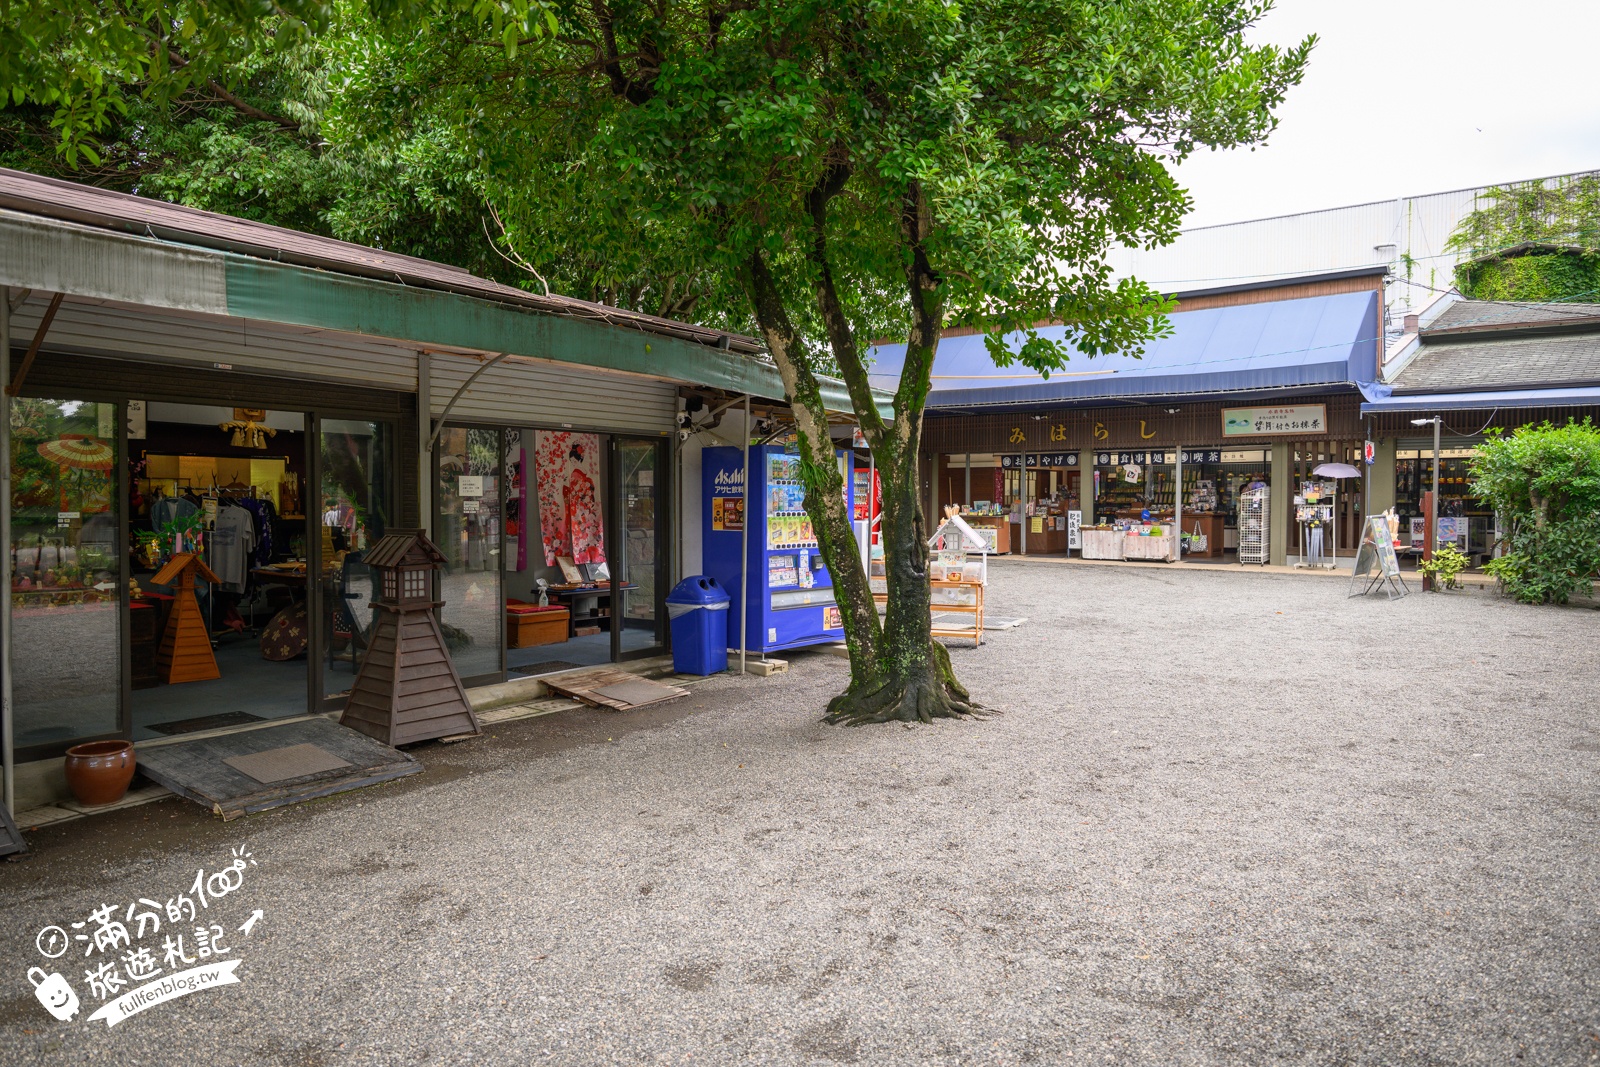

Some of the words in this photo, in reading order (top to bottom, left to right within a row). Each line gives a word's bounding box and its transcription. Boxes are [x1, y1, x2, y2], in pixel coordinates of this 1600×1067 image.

[1009, 420, 1157, 444] みはらし
[1015, 456, 1063, 467] おみやげ
[1119, 453, 1162, 464] 食事処
[1193, 451, 1219, 463] 喫茶
[714, 467, 744, 485] Asahi
[714, 485, 744, 494] アサヒ飲料
